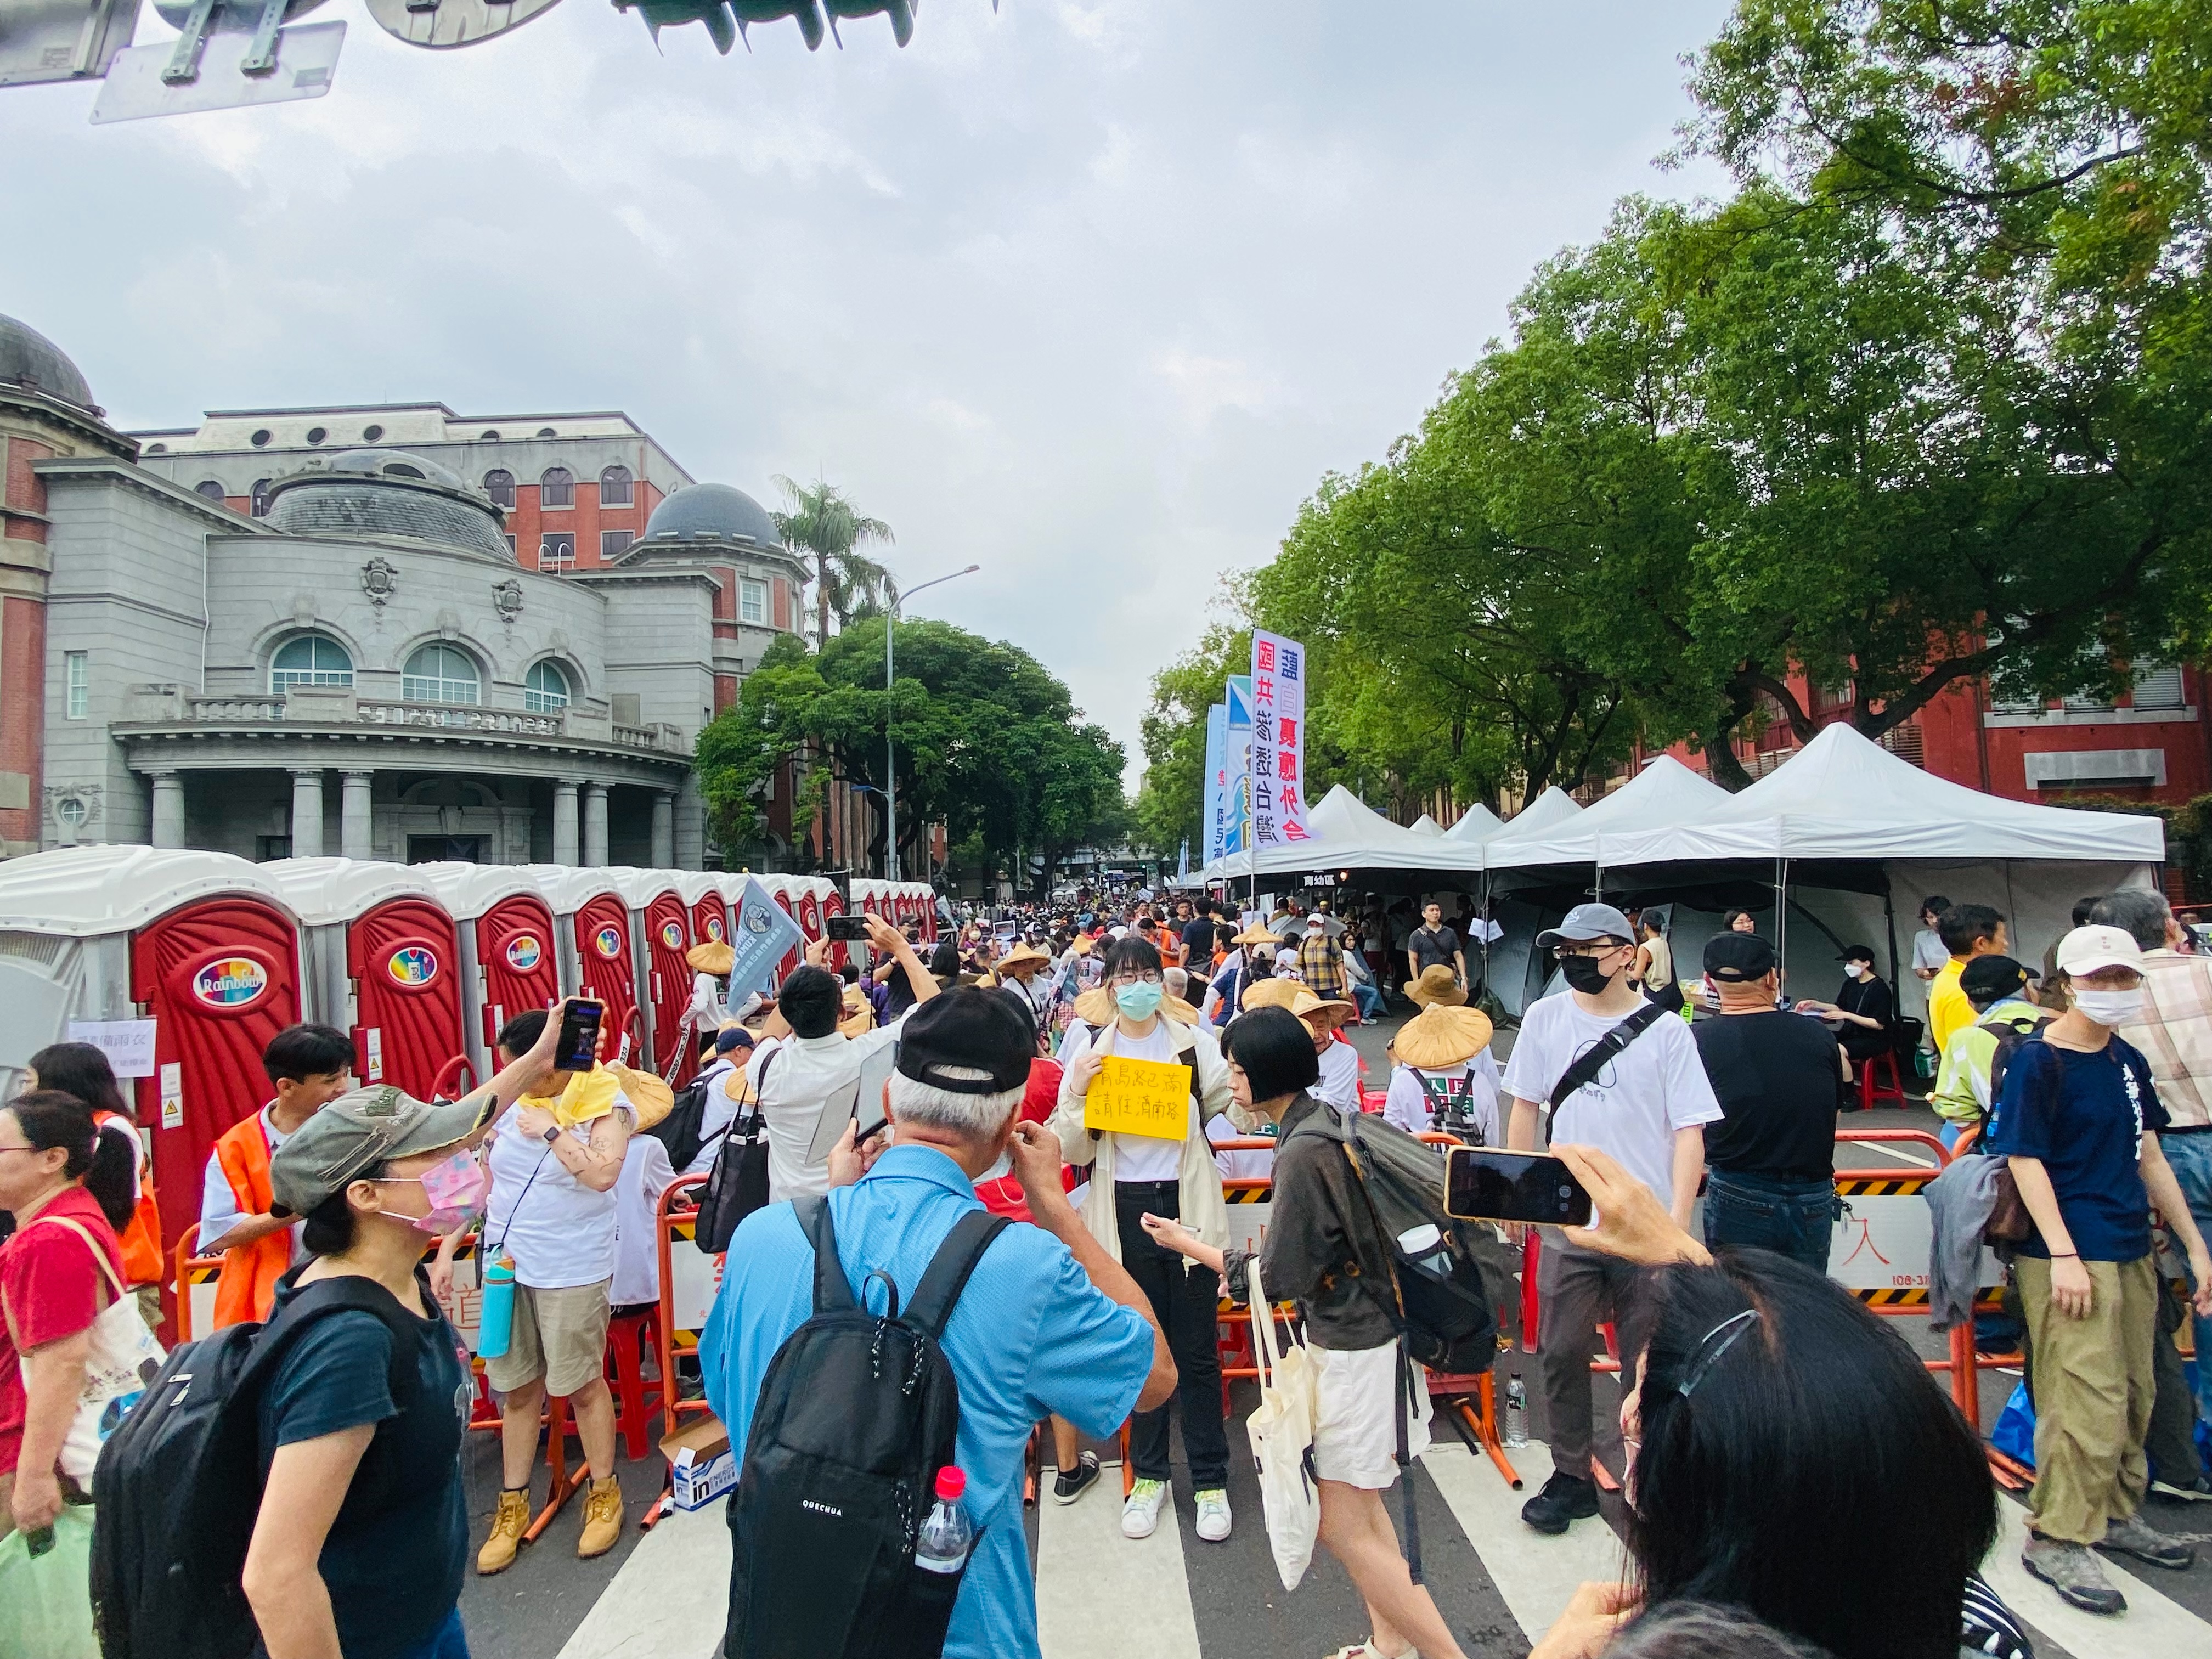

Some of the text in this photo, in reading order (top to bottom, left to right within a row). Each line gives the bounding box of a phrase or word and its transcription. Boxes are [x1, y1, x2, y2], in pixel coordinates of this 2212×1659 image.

[203, 969, 260, 992] Rainbow
[693, 1481, 709, 1503] in
[802, 1499, 842, 1516] QUECHUA
